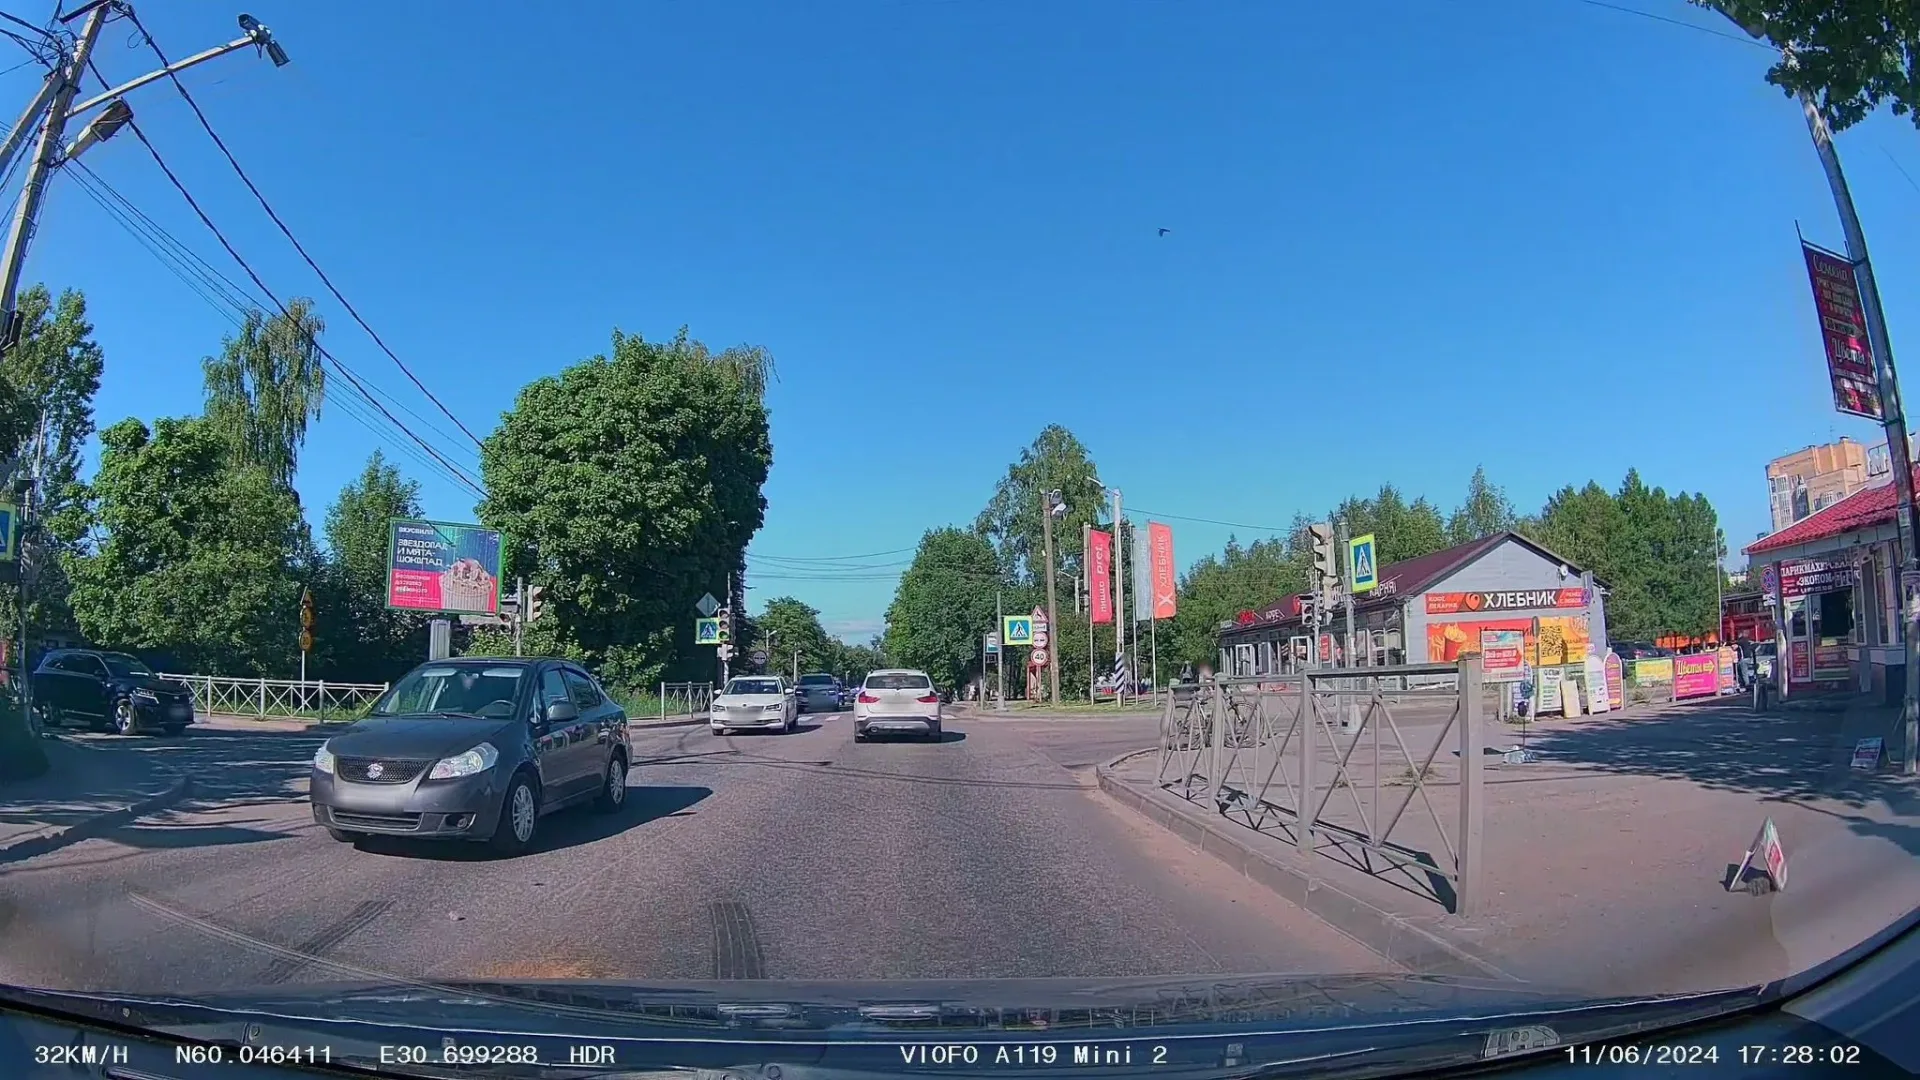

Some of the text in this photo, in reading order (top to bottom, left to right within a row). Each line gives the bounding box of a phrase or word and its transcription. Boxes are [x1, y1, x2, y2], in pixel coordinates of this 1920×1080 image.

[397, 538, 448, 551] ЗВЕЗДОПАД
[397, 547, 405, 555] И
[396, 555, 443, 566] ШОКОЛАД
[1483, 591, 1557, 609] ХЛЕБНИК
[1034, 653, 1045, 661] 40
